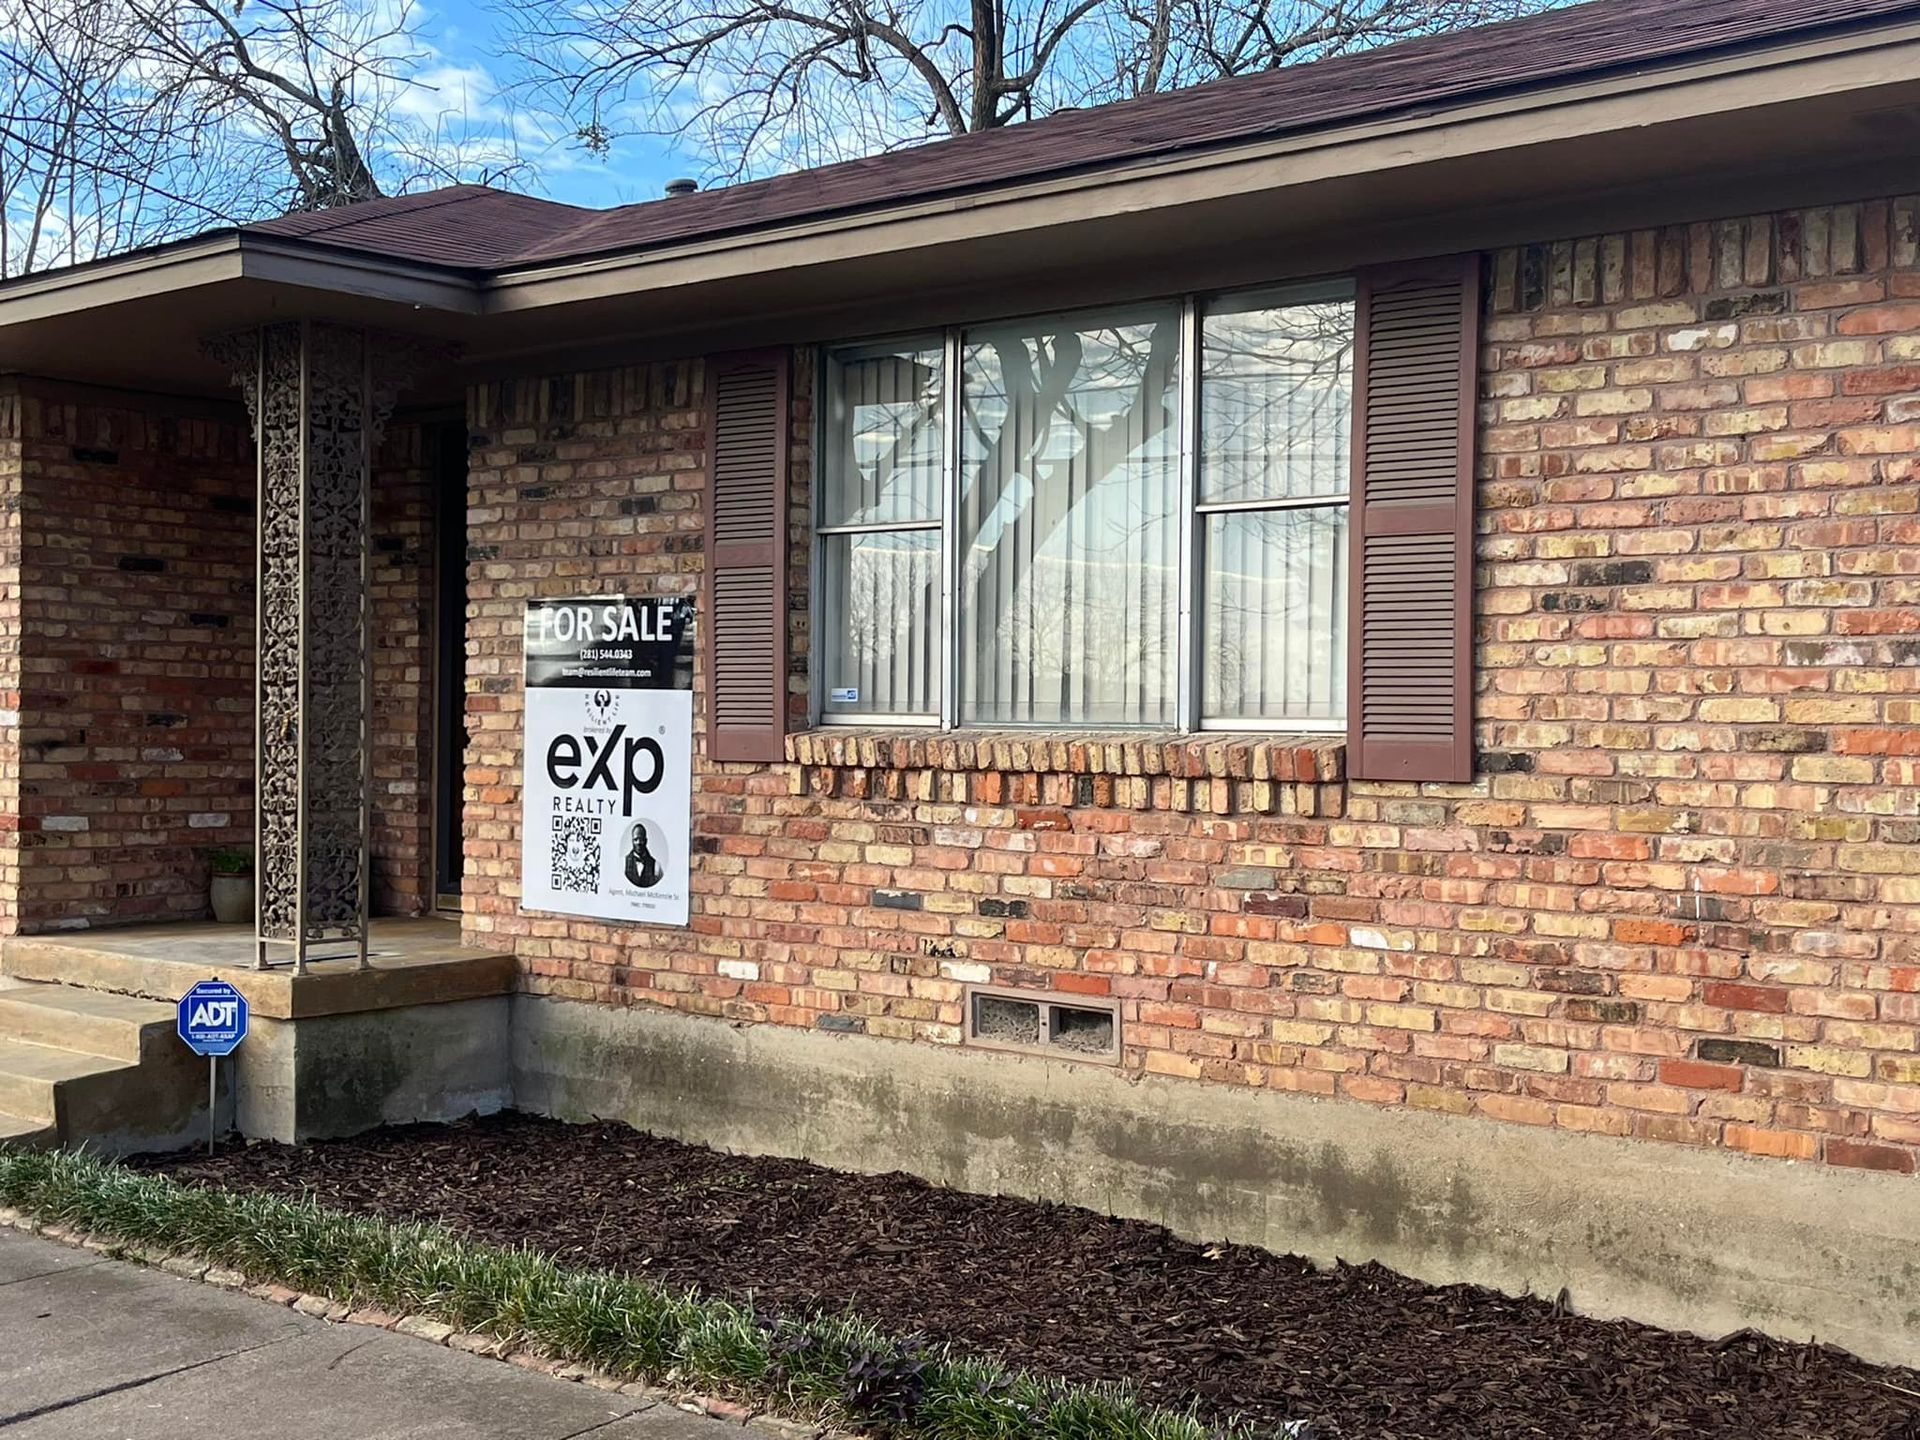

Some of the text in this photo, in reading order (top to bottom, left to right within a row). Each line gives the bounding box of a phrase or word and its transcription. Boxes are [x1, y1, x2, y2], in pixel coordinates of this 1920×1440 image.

[540, 605, 674, 642] FOR SALE
[579, 649, 633, 661] (281) 544.0343
[561, 667, 652, 678] team@resilientlifeteam.com
[552, 796, 616, 815] REALTY
[189, 1001, 238, 1027] ADT
